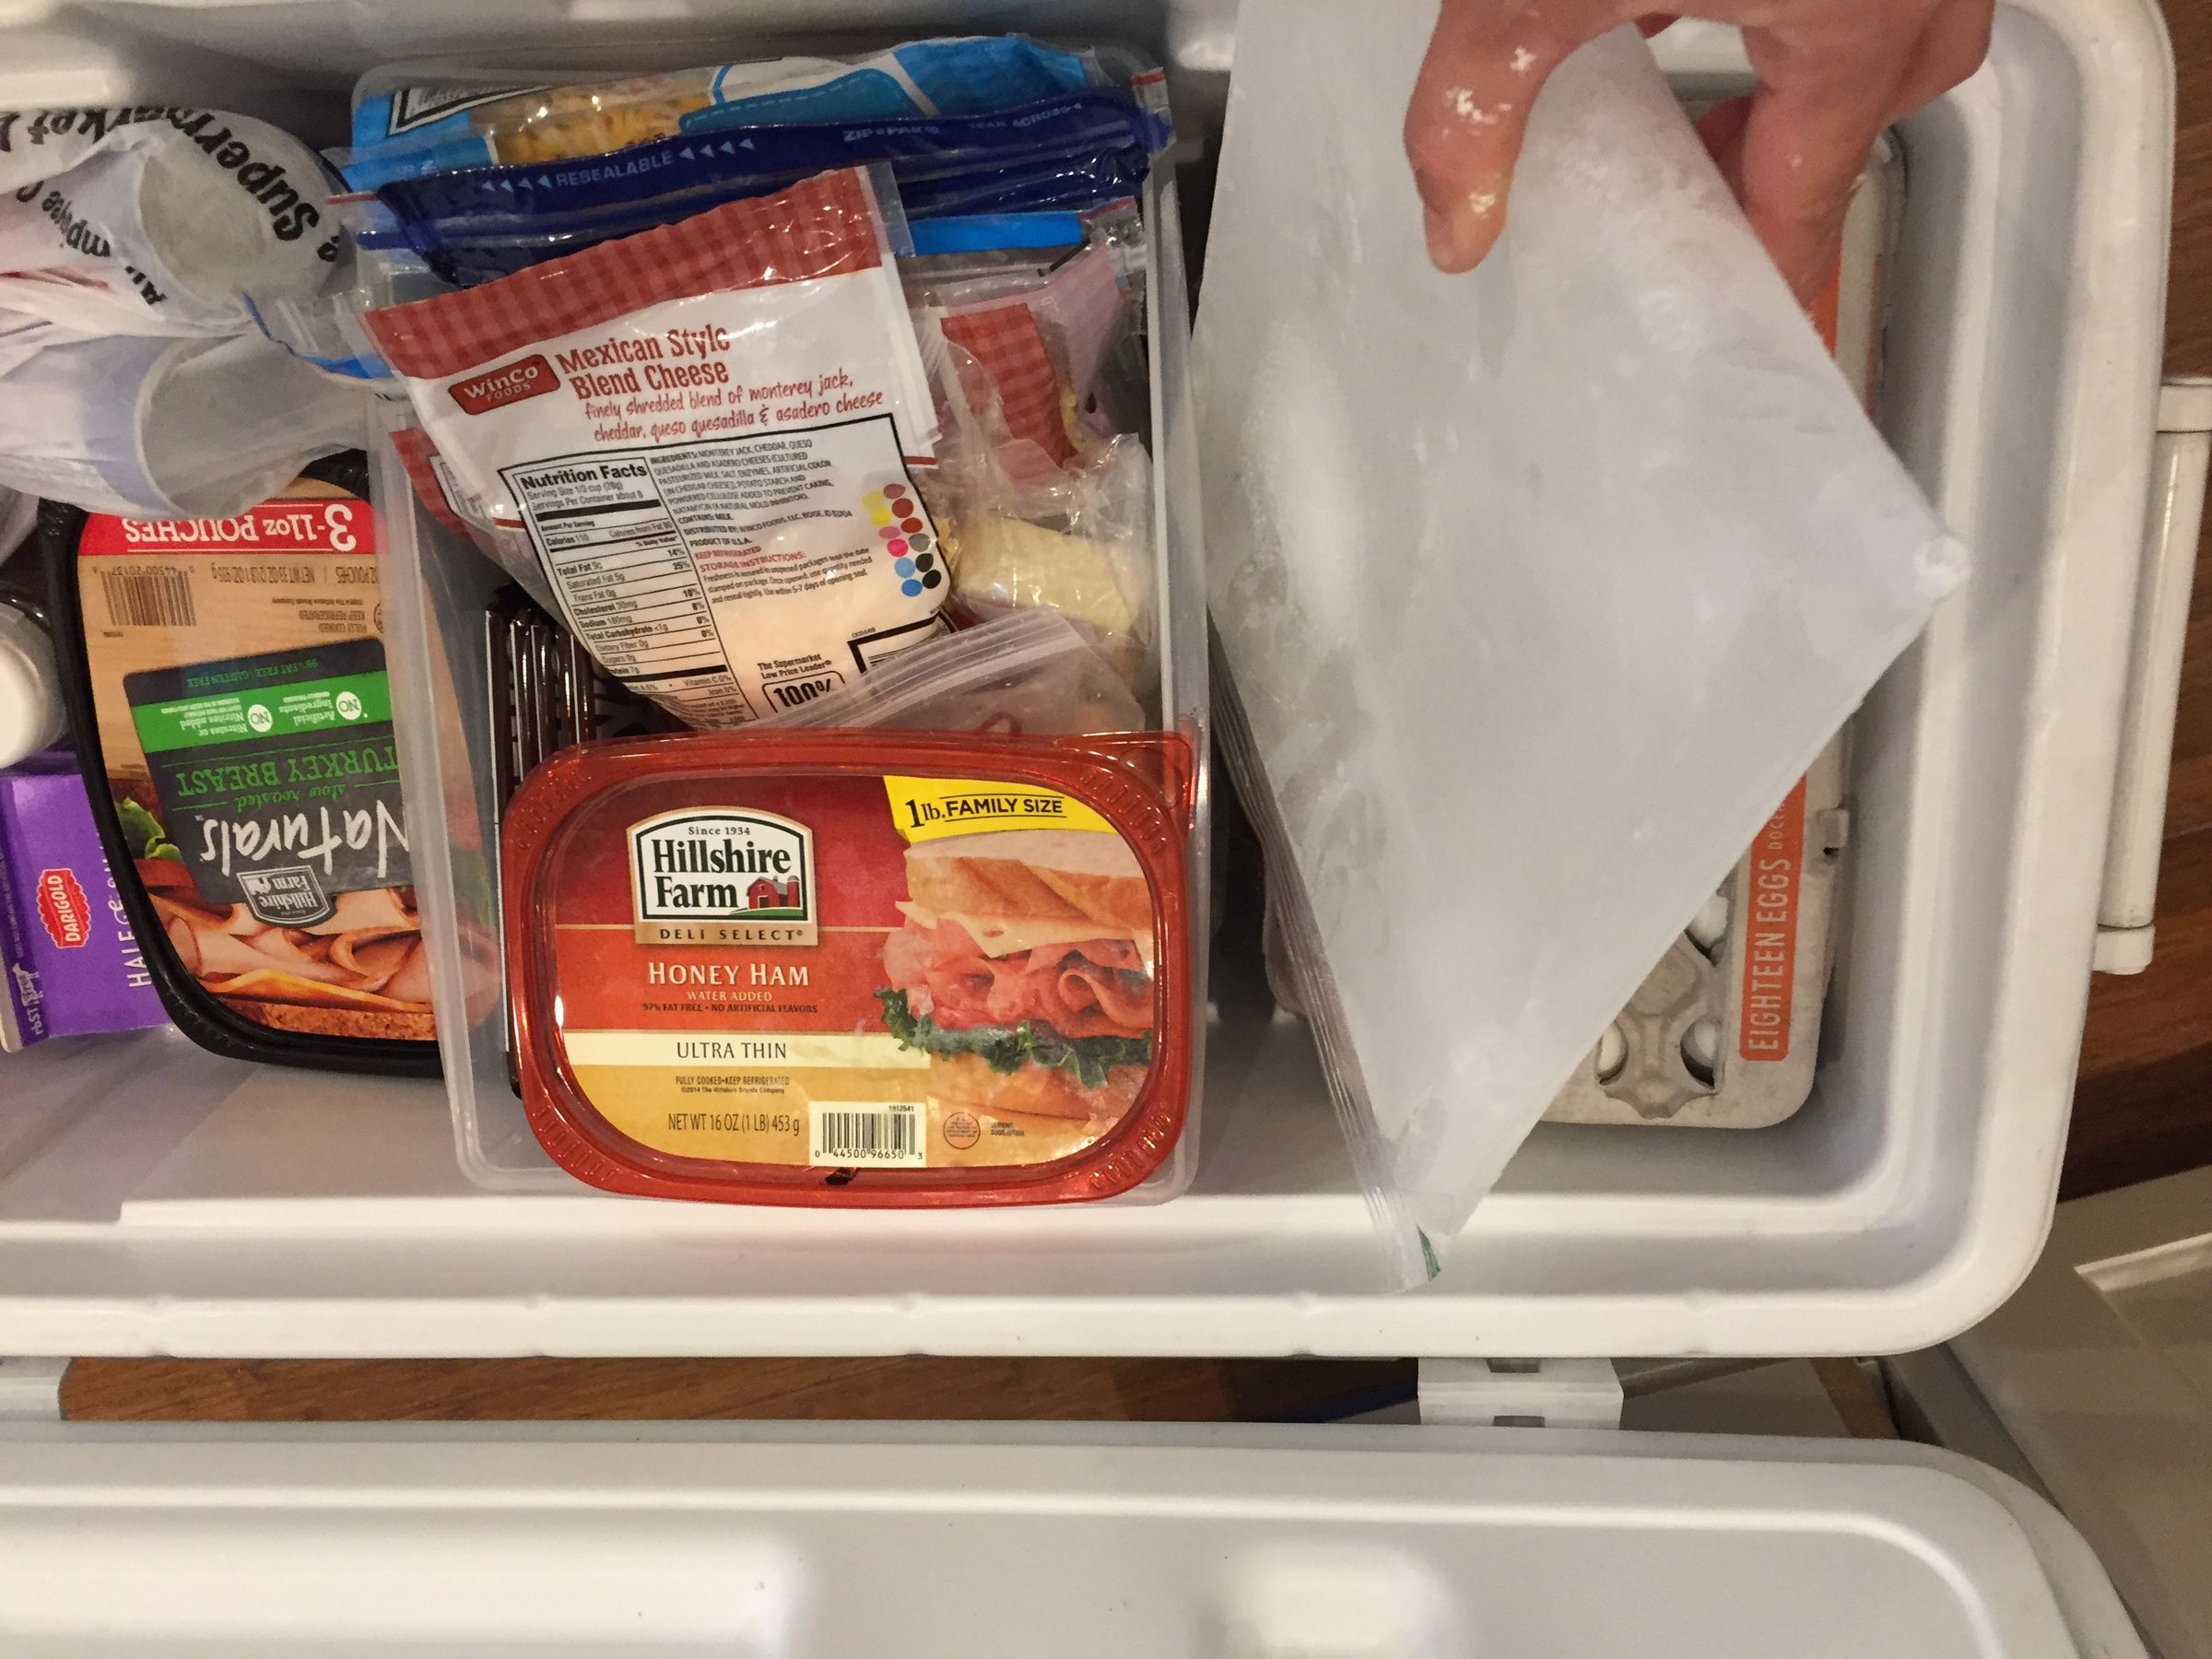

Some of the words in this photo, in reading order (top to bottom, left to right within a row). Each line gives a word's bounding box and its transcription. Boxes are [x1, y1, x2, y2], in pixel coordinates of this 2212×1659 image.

[557, 150, 674, 187] RESEALABLE
[555, 337, 664, 374] Mexican
[667, 324, 730, 359] Style
[464, 366, 538, 399] WinCo
[569, 367, 641, 400] Blend
[644, 361, 729, 391] Cheese
[486, 382, 532, 403] FOODS
[585, 400, 622, 420] finely
[626, 394, 685, 416] shredded
[689, 388, 722, 409] blend
[728, 385, 743, 404] of
[749, 380, 813, 402] monterey
[818, 368, 853, 396] jack,
[651, 421, 687, 442] queso
[691, 410, 756, 438] quesadilla
[759, 404, 770, 426] &
[776, 401, 830, 421] asadero
[836, 391, 883, 413] cheese
[520, 468, 598, 489] Nutrition
[599, 464, 648, 479] Facts
[527, 488, 558, 500] Serving
[579, 494, 614, 504] Container
[122, 514, 261, 542] POUCHES
[546, 535, 575, 546] Calories
[557, 565, 577, 576] Total
[578, 562, 592, 572] Fat
[673, 560, 690, 571] 25%
[700, 561, 740, 572] STORAGE
[602, 574, 614, 583] Fat
[573, 604, 616, 617] Cholesterol
[586, 631, 604, 641] Total
[605, 625, 653, 639] Carbohydrate
[757, 662, 772, 671] The
[773, 653, 822, 669] Supermarket
[760, 671, 778, 679] Low
[779, 667, 799, 677] Price
[278, 699, 333, 713] Ingredients
[338, 698, 360, 713] NO
[249, 711, 270, 725] NO
[293, 711, 335, 726] Artificial
[288, 746, 399, 782] TURKEY
[176, 761, 281, 796] BREAST
[234, 790, 300, 812] roasted
[945, 797, 1018, 818] FAMILY
[1024, 799, 1064, 814] SIZE
[200, 799, 410, 878] Naturals
[688, 826, 721, 836] Since
[725, 826, 751, 836] 1934
[651, 838, 791, 874] Hillshire
[271, 875, 311, 891] Farm
[1754, 858, 1792, 924] EGGS
[258, 891, 318, 910] Hillshire
[654, 876, 740, 909] Farm
[47, 875, 81, 942] DARIGOLD
[660, 928, 705, 940] DELI
[648, 961, 740, 985] HONEY
[750, 963, 810, 986] HAM
[687, 991, 727, 1002] WATER
[731, 991, 773, 1002] ADDED
[1747, 931, 1785, 1051] EIGHTEEN
[642, 1003, 661, 1012] 97%
[662, 1003, 678, 1011] FAT
[680, 1003, 703, 1012] FREE
[711, 1004, 724, 1012] NO
[727, 1004, 776, 1013] ARTIFICIAL
[778, 1004, 818, 1014] FLAVORS
[677, 1041, 735, 1059] ULTRA
[740, 1041, 787, 1059] THIN
[675, 1076, 696, 1085] FULLY
[742, 1076, 790, 1086] REFRIGERATED
[759, 1087, 785, 1095] Company
[668, 1113, 688, 1131] NET
[689, 1113, 707, 1131] WT
[710, 1113, 722, 1131] 16
[724, 1113, 739, 1132] OZ
[741, 1113, 750, 1134] (1
[753, 1113, 771, 1135] LB)
[771, 1114, 791, 1132] 453
[793, 1118, 800, 1136] g
[815, 1149, 820, 1159] 0
[832, 1148, 866, 1159] 44500
[870, 1149, 904, 1159] 96650
[917, 1151, 924, 1160] 3
